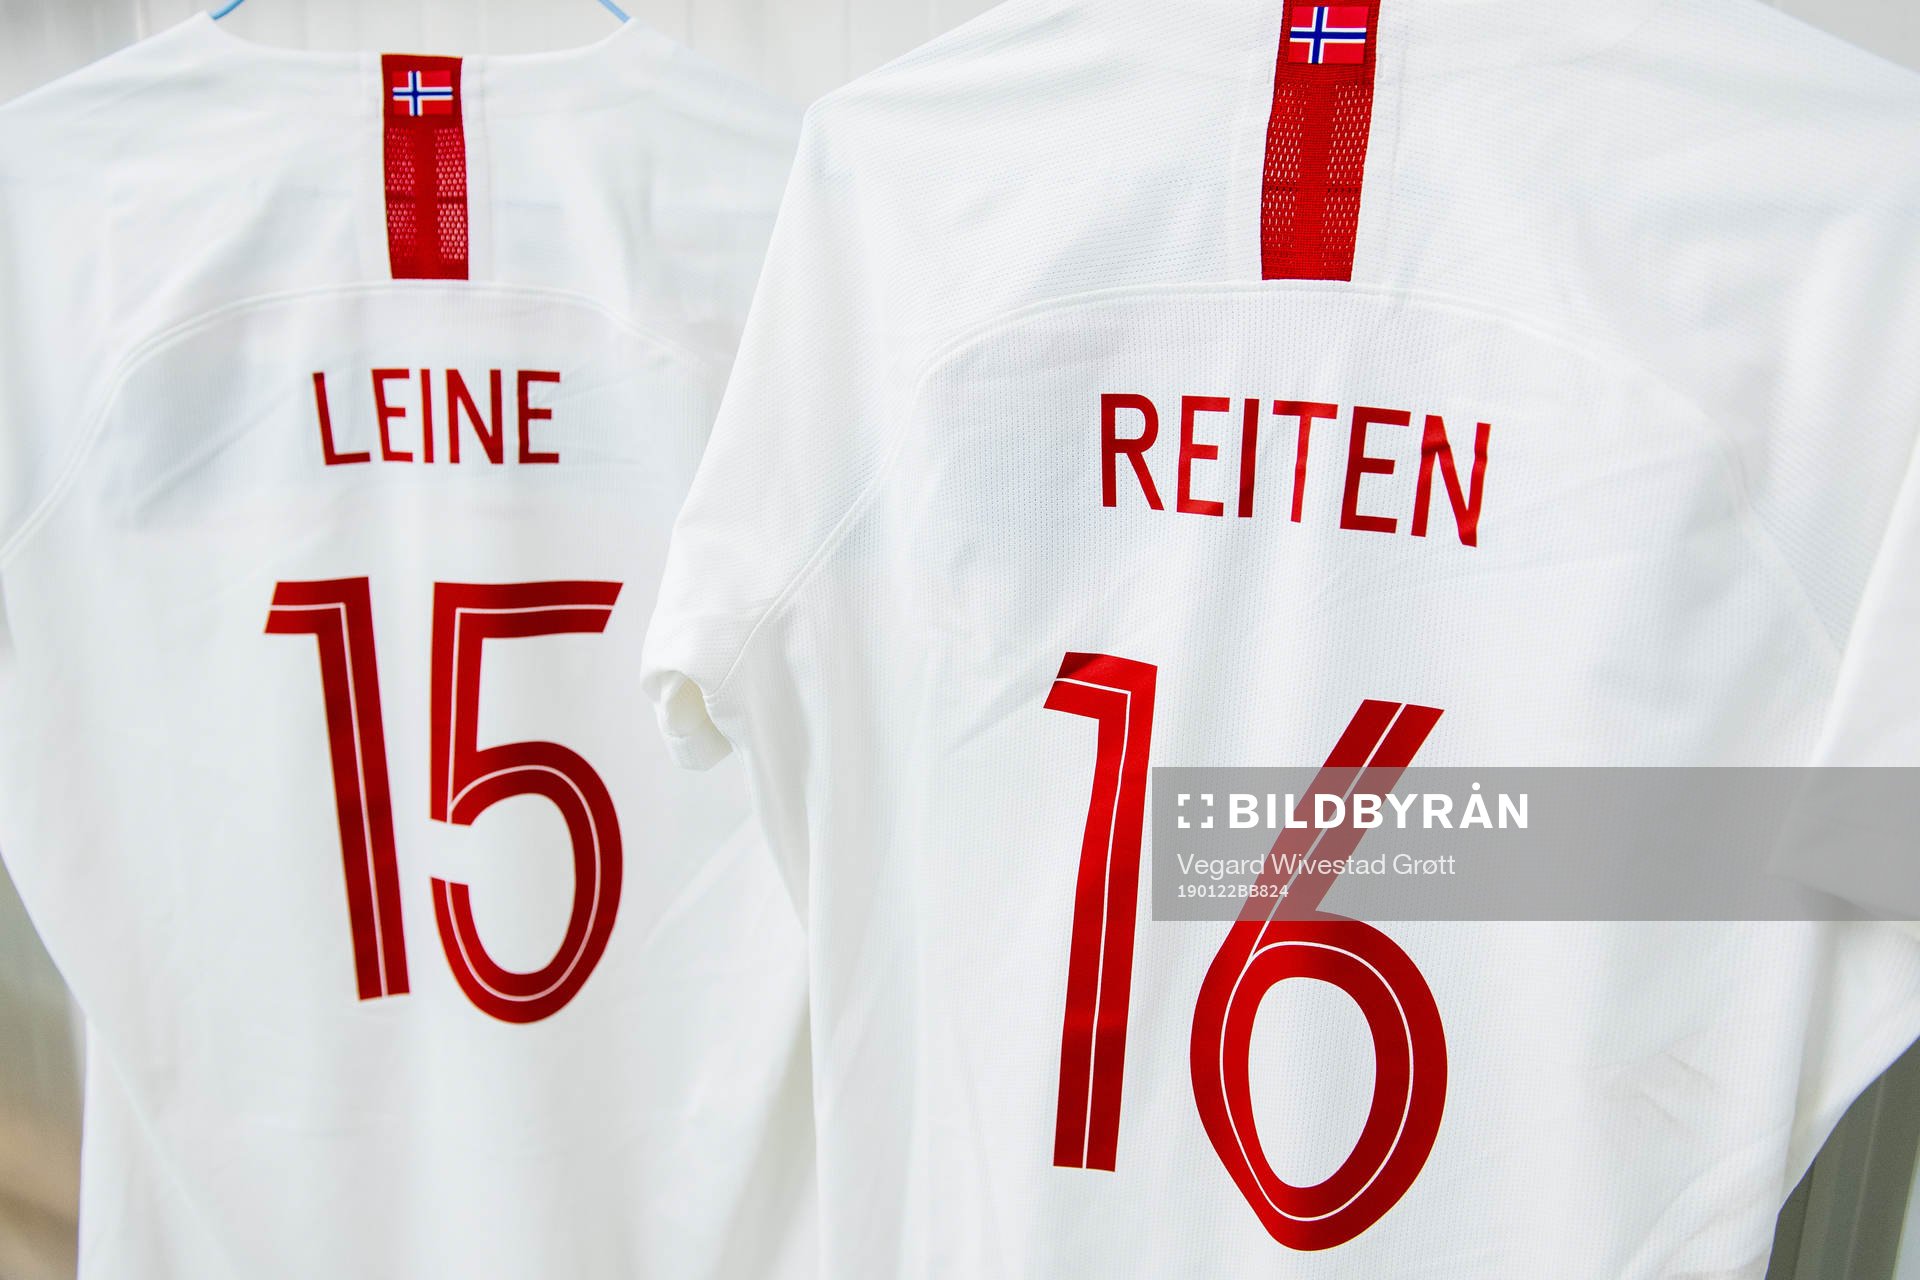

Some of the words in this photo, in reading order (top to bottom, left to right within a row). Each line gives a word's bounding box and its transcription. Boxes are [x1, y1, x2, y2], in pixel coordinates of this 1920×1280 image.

[312, 367, 561, 467] LEINE
[1100, 392, 1492, 548] REITEN
[263, 575, 624, 1025] 15
[1042, 651, 1449, 1252] 16
